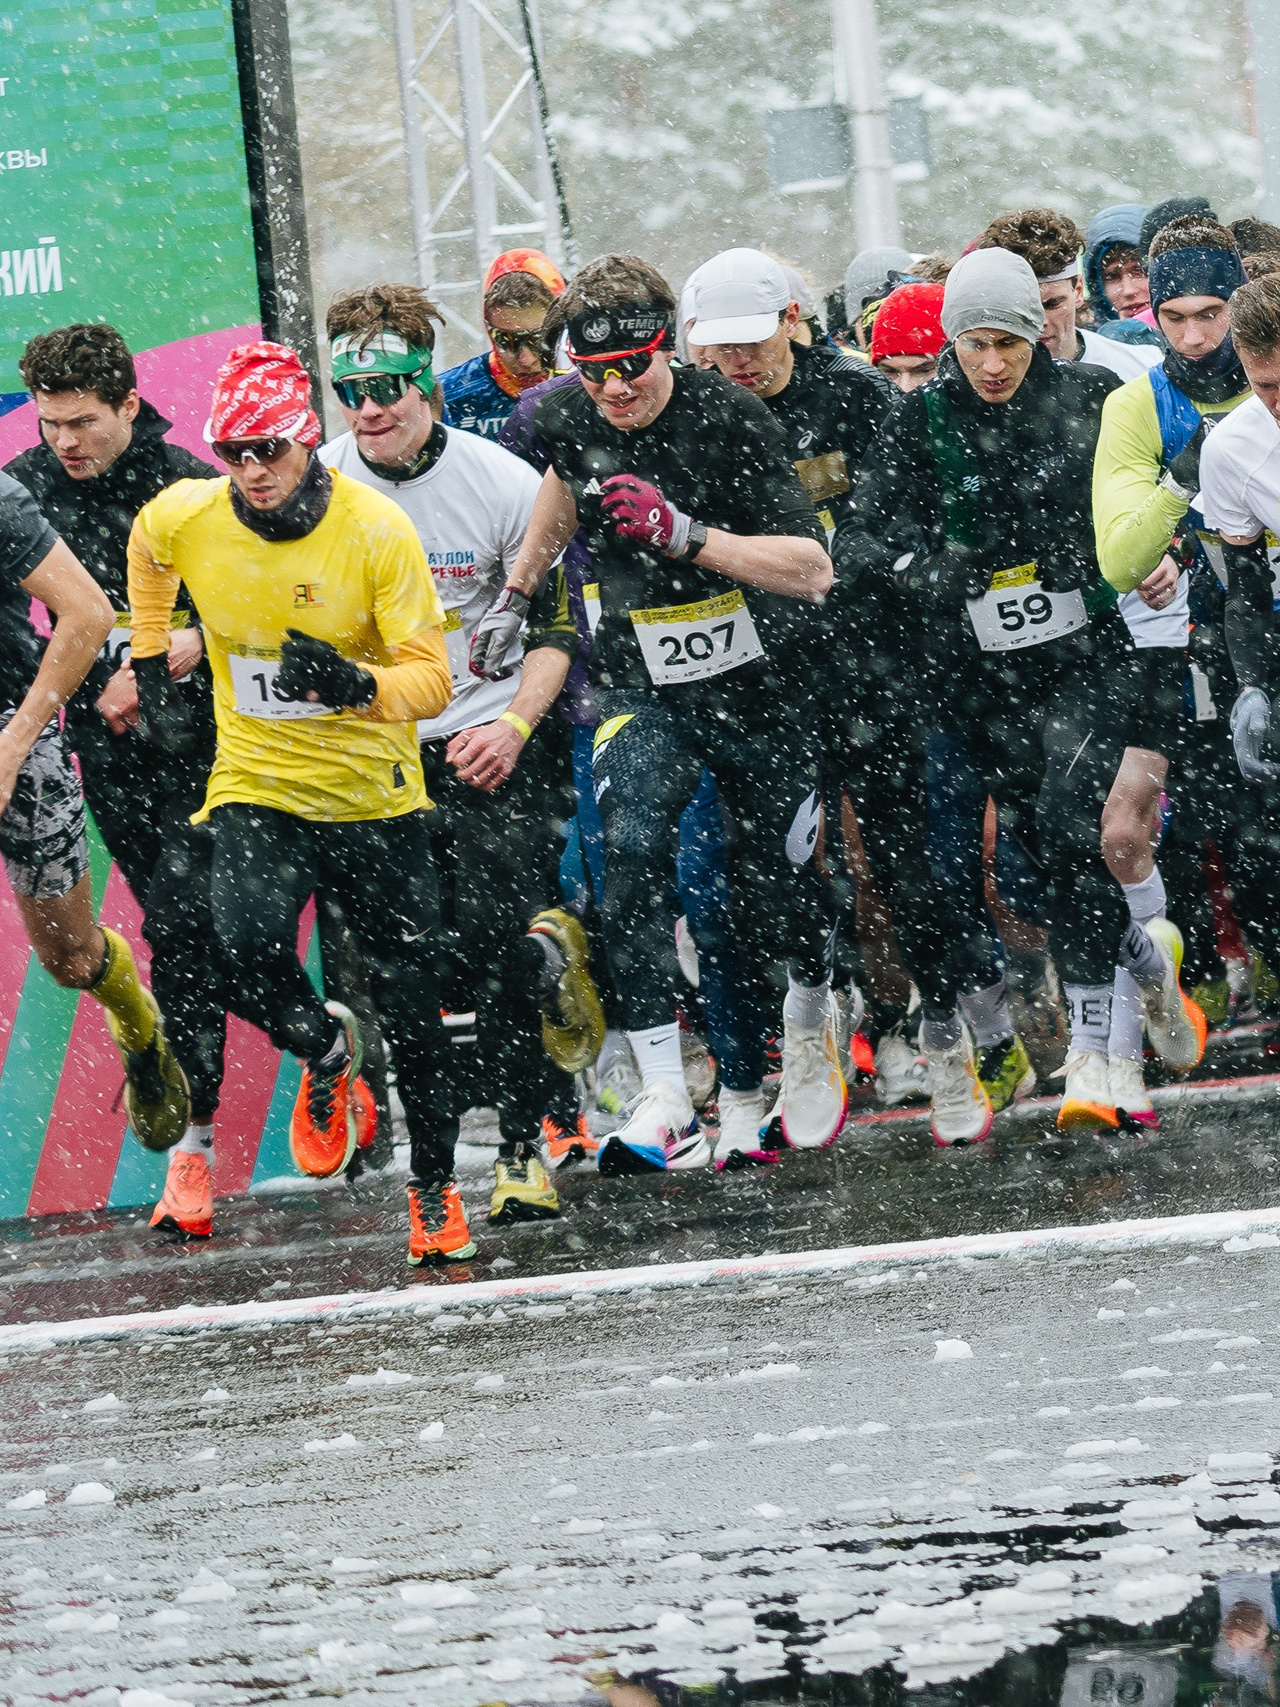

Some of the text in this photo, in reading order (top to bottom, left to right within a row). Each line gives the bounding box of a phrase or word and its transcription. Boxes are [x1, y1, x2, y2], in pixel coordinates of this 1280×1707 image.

[707, 597, 734, 611] ЭТАП
[996, 593, 1053, 632] 59
[657, 620, 736, 666] 207
